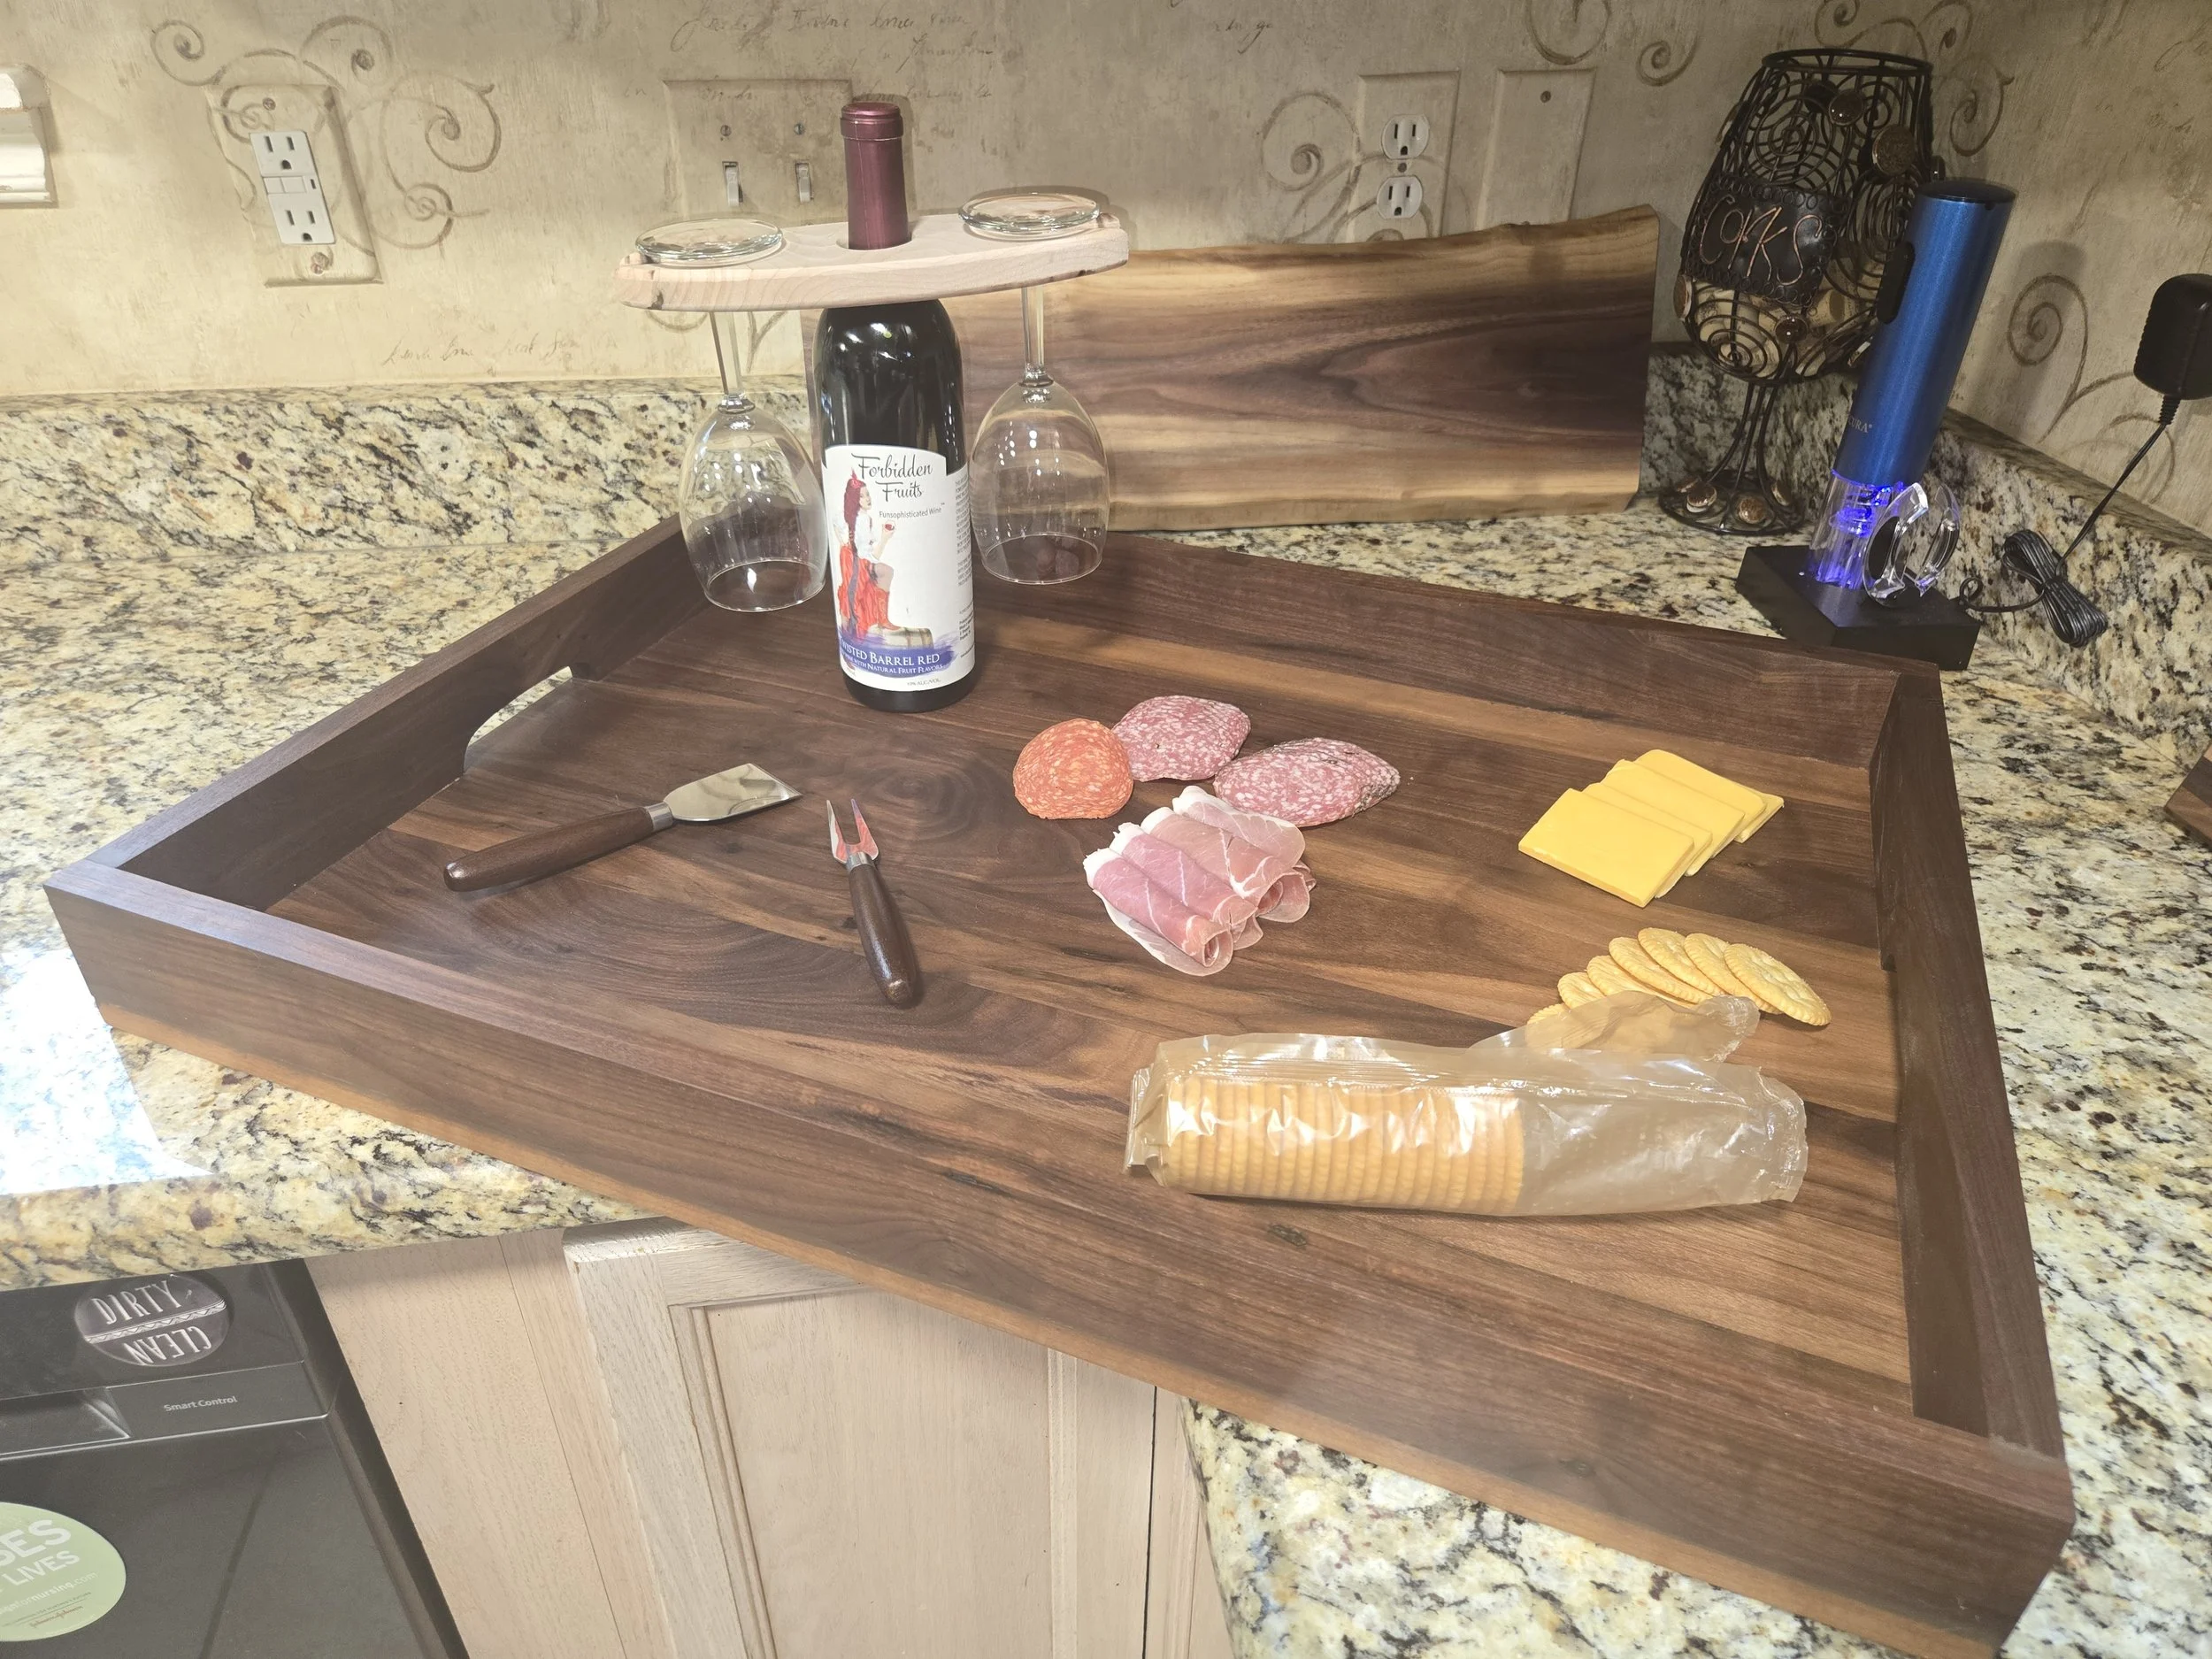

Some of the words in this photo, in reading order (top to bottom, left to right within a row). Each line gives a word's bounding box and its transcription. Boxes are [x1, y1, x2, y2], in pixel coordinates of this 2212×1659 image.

[851, 453, 933, 479] Forbidden
[875, 480, 923, 502] Fruits
[879, 509, 929, 519] Funsophisticated
[929, 507, 942, 516] Wine
[867, 663, 896, 674] NATURAL
[918, 664, 943, 673] FLAVORS
[870, 651, 914, 666] BARREL
[918, 654, 940, 665] RED
[91, 1280, 181, 1325] DIRTY
[123, 1326, 211, 1365] CLEAN
[164, 1402, 196, 1411] Smart
[198, 1395, 238, 1407] Control
[2, 1550, 81, 1586] LIVES
